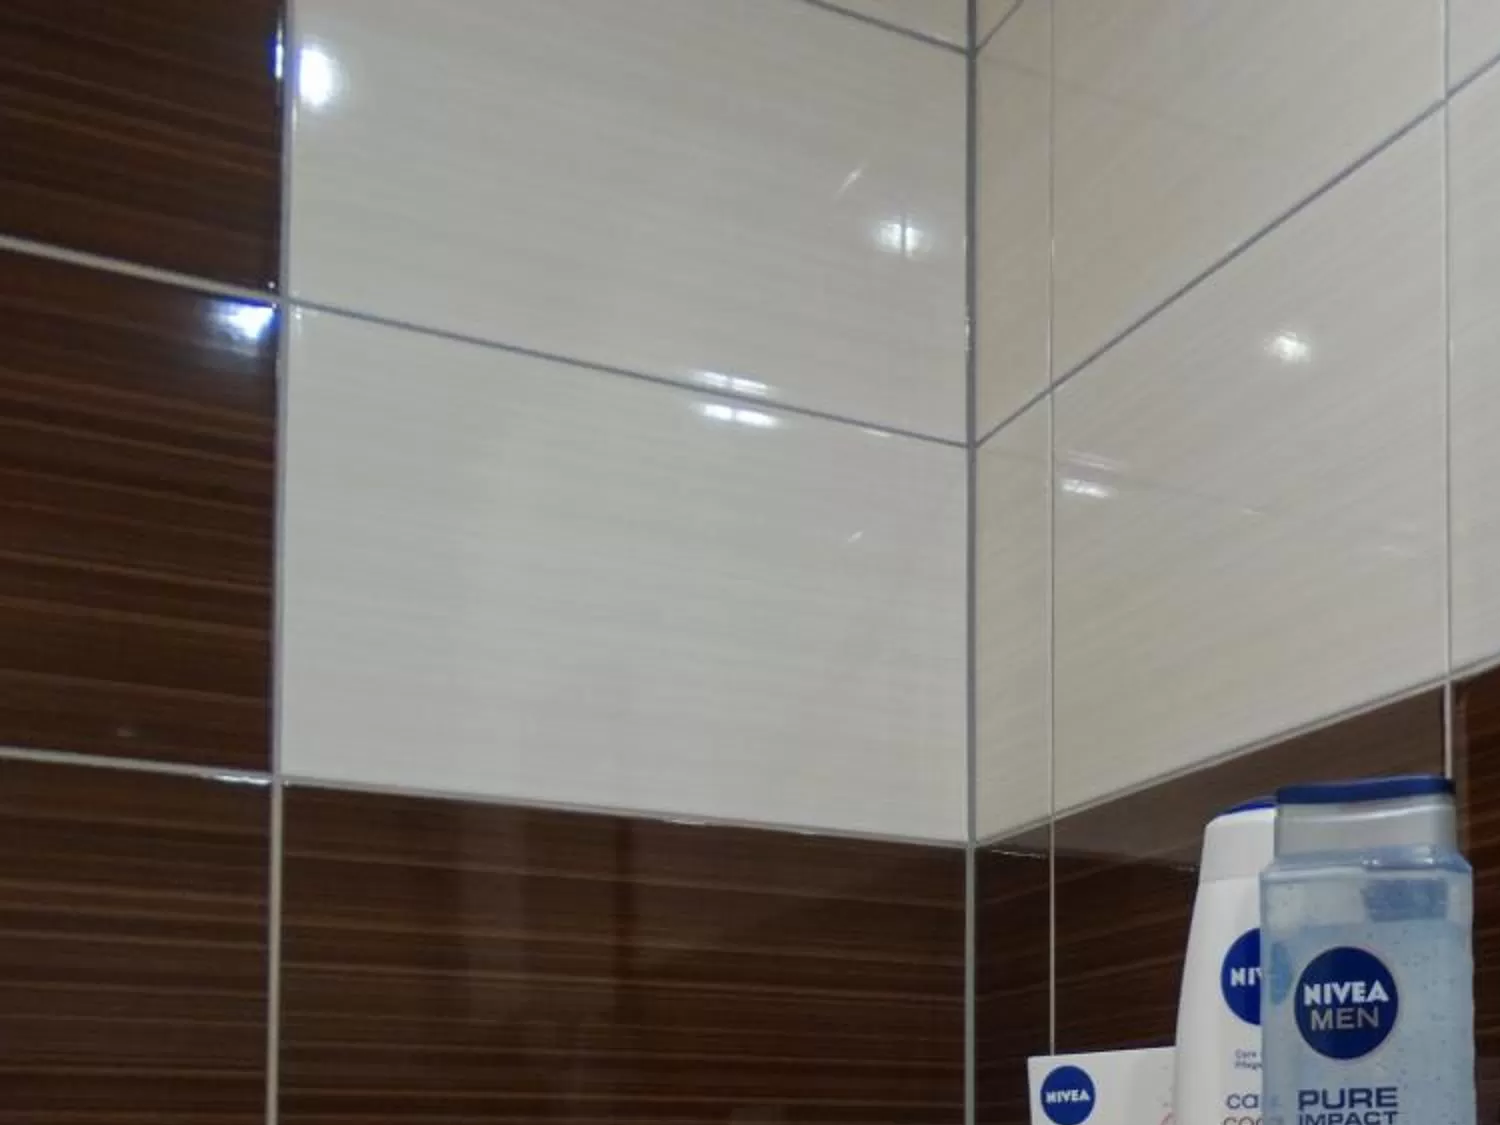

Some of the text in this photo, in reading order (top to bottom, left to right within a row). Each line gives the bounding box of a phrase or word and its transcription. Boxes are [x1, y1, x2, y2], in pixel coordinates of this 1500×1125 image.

[1303, 980, 1389, 1006] NIVEA
[1311, 1006, 1379, 1031] MEN
[1044, 1088, 1091, 1105] NIVEA
[1297, 1086, 1399, 1111] PURE
